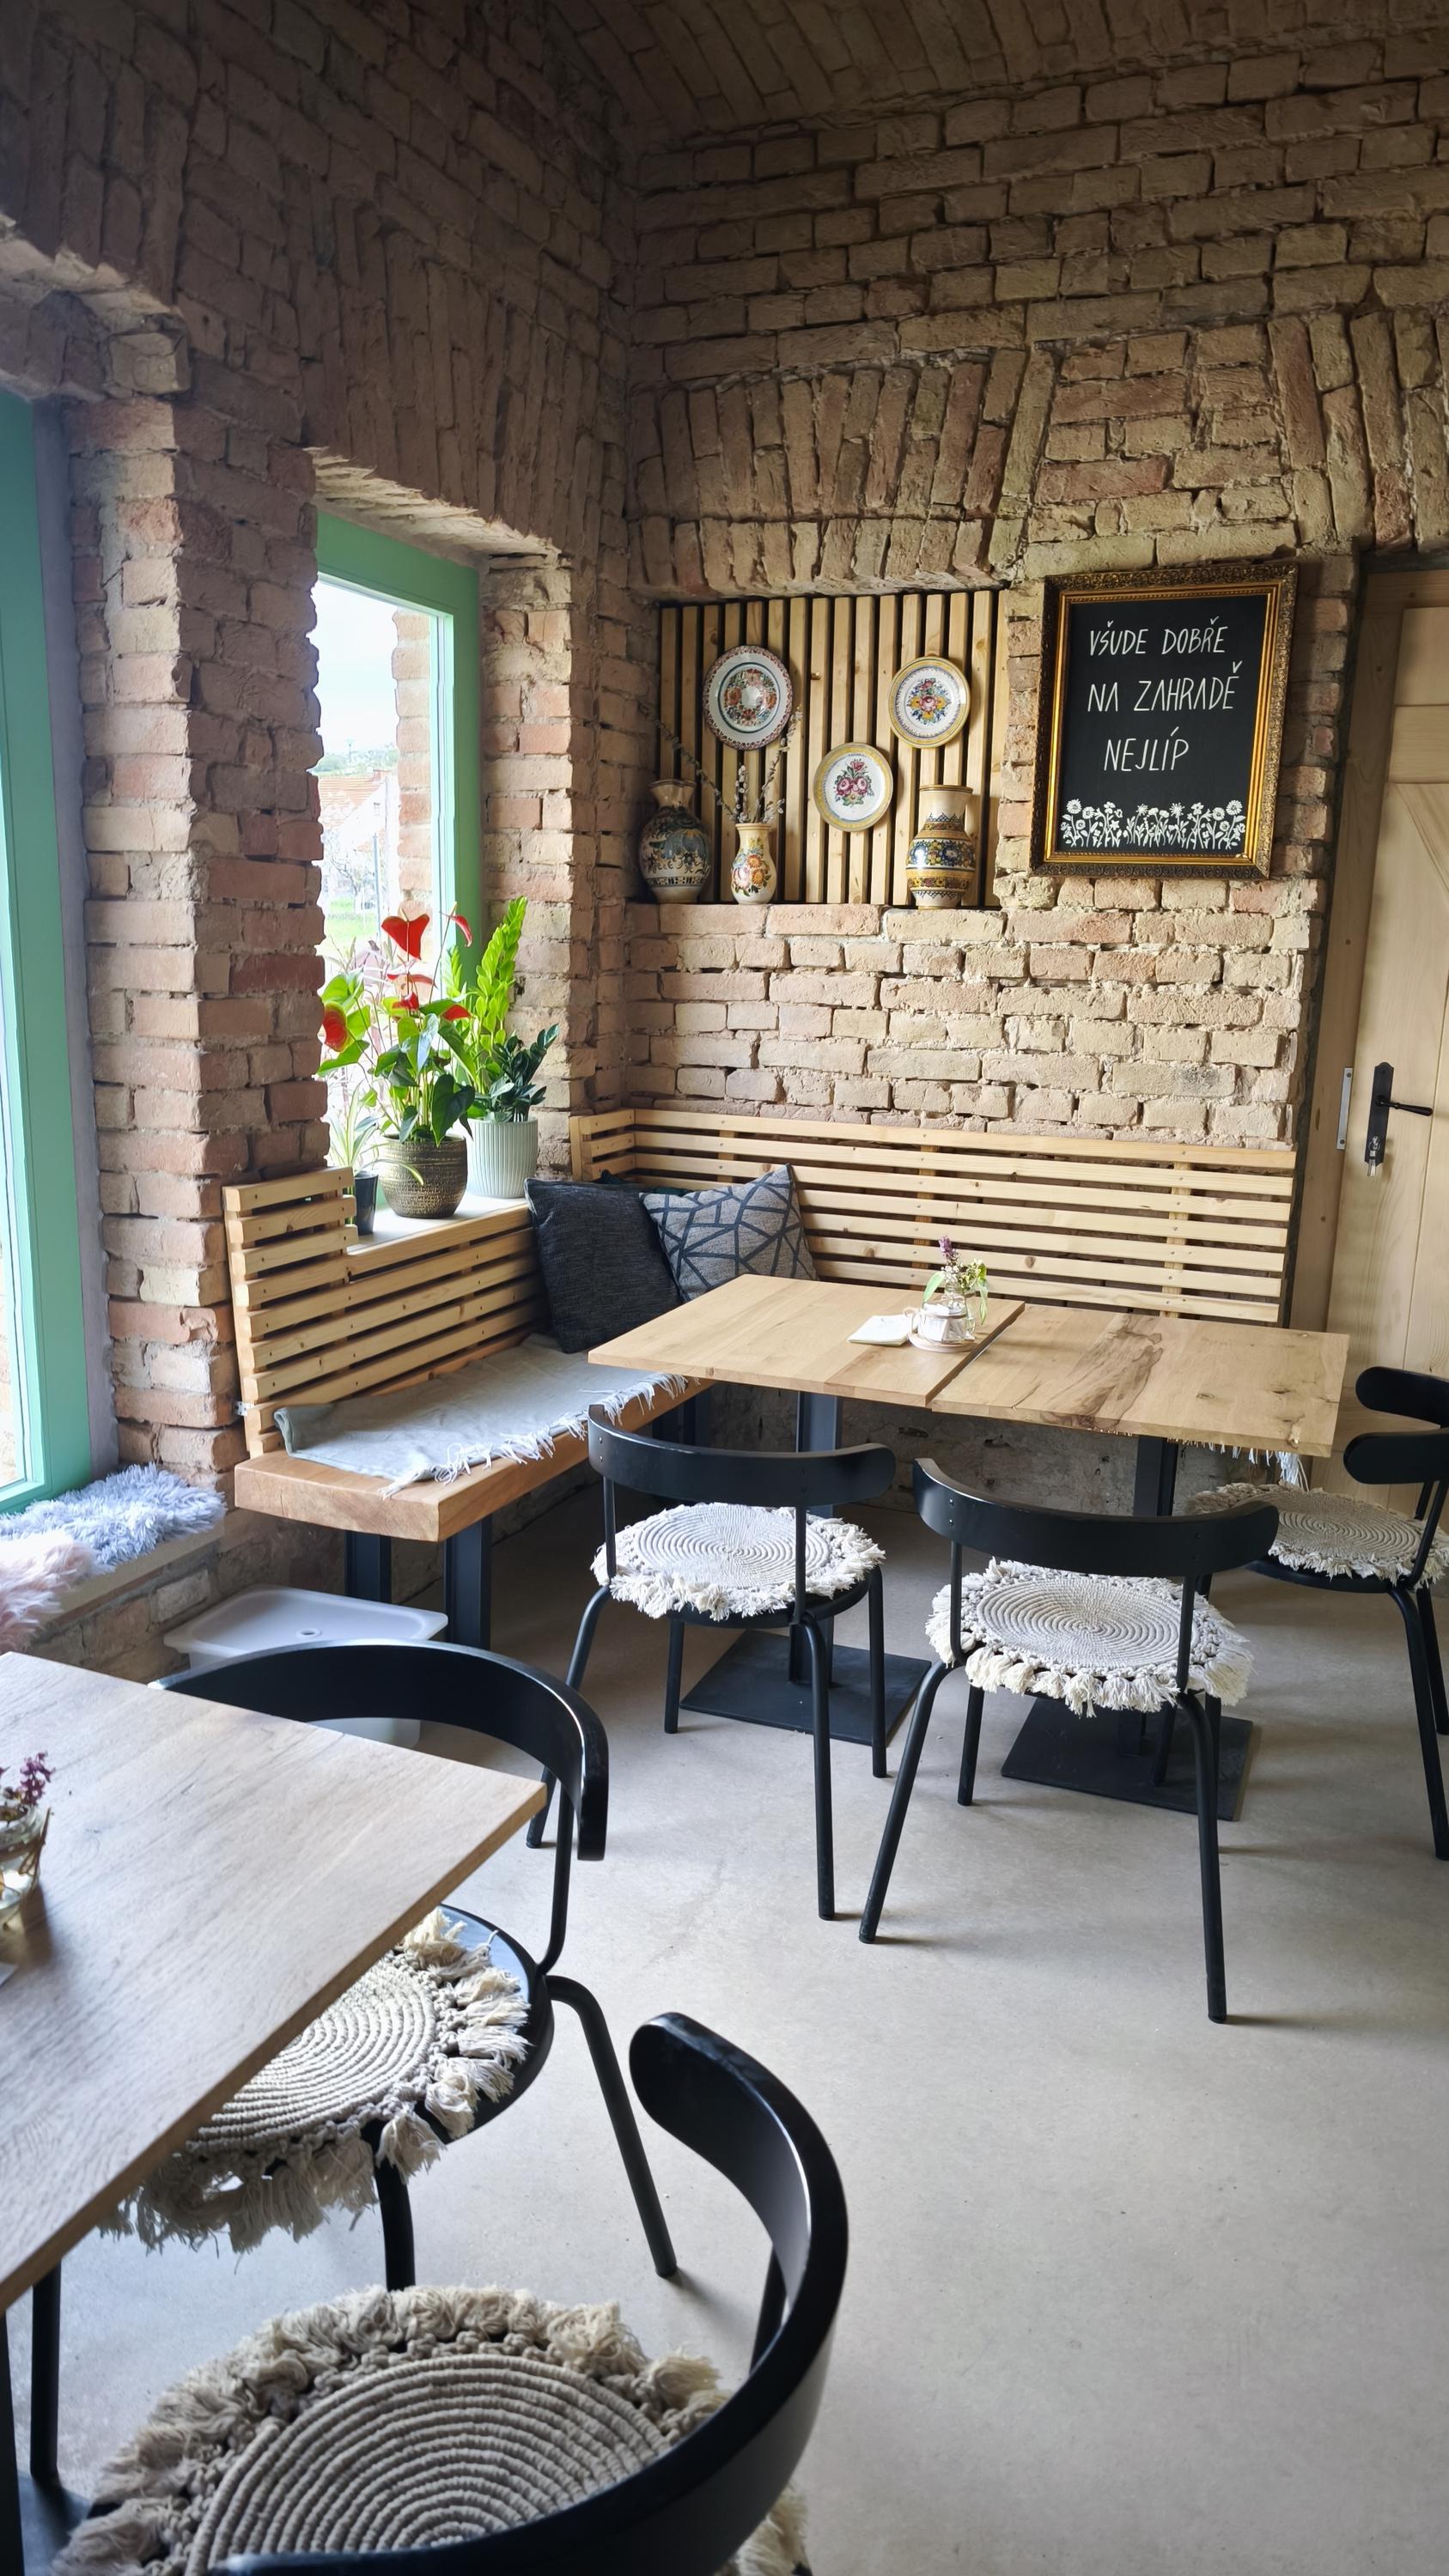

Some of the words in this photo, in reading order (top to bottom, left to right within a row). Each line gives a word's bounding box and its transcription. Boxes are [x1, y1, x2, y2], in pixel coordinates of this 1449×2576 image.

[1090, 620, 1148, 656] VŠUDE
[1161, 616, 1228, 655] DOBŘE
[1087, 681, 1118, 712] NA
[1133, 660, 1243, 712] ZAHRADĚ
[1104, 726, 1190, 772] NEJLÍP
